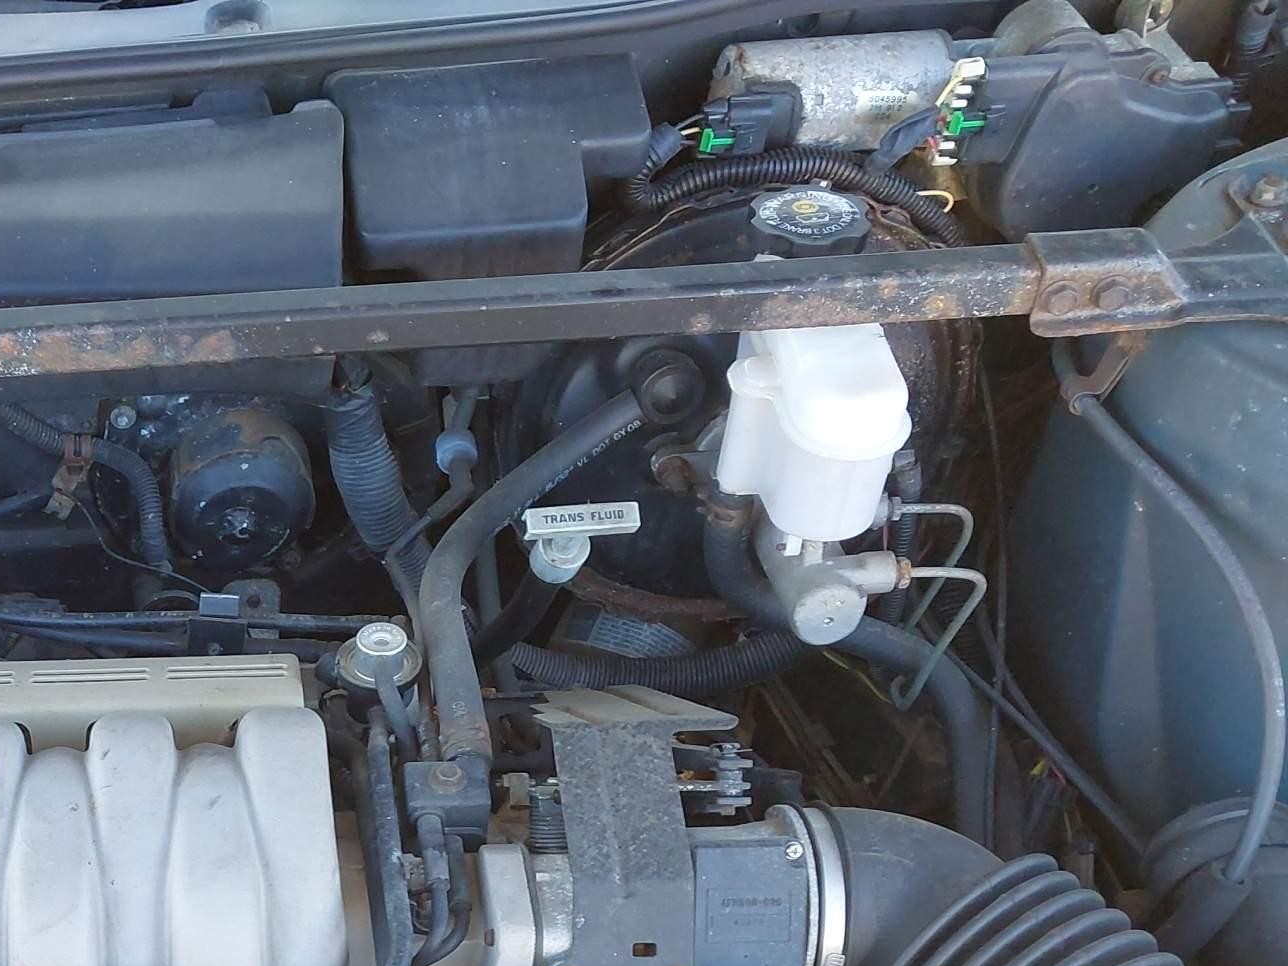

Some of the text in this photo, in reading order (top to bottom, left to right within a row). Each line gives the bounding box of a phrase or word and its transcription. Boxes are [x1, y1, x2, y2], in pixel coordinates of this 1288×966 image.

[778, 222, 813, 235] BRAKE
[542, 508, 625, 525] TRANS FLUID
